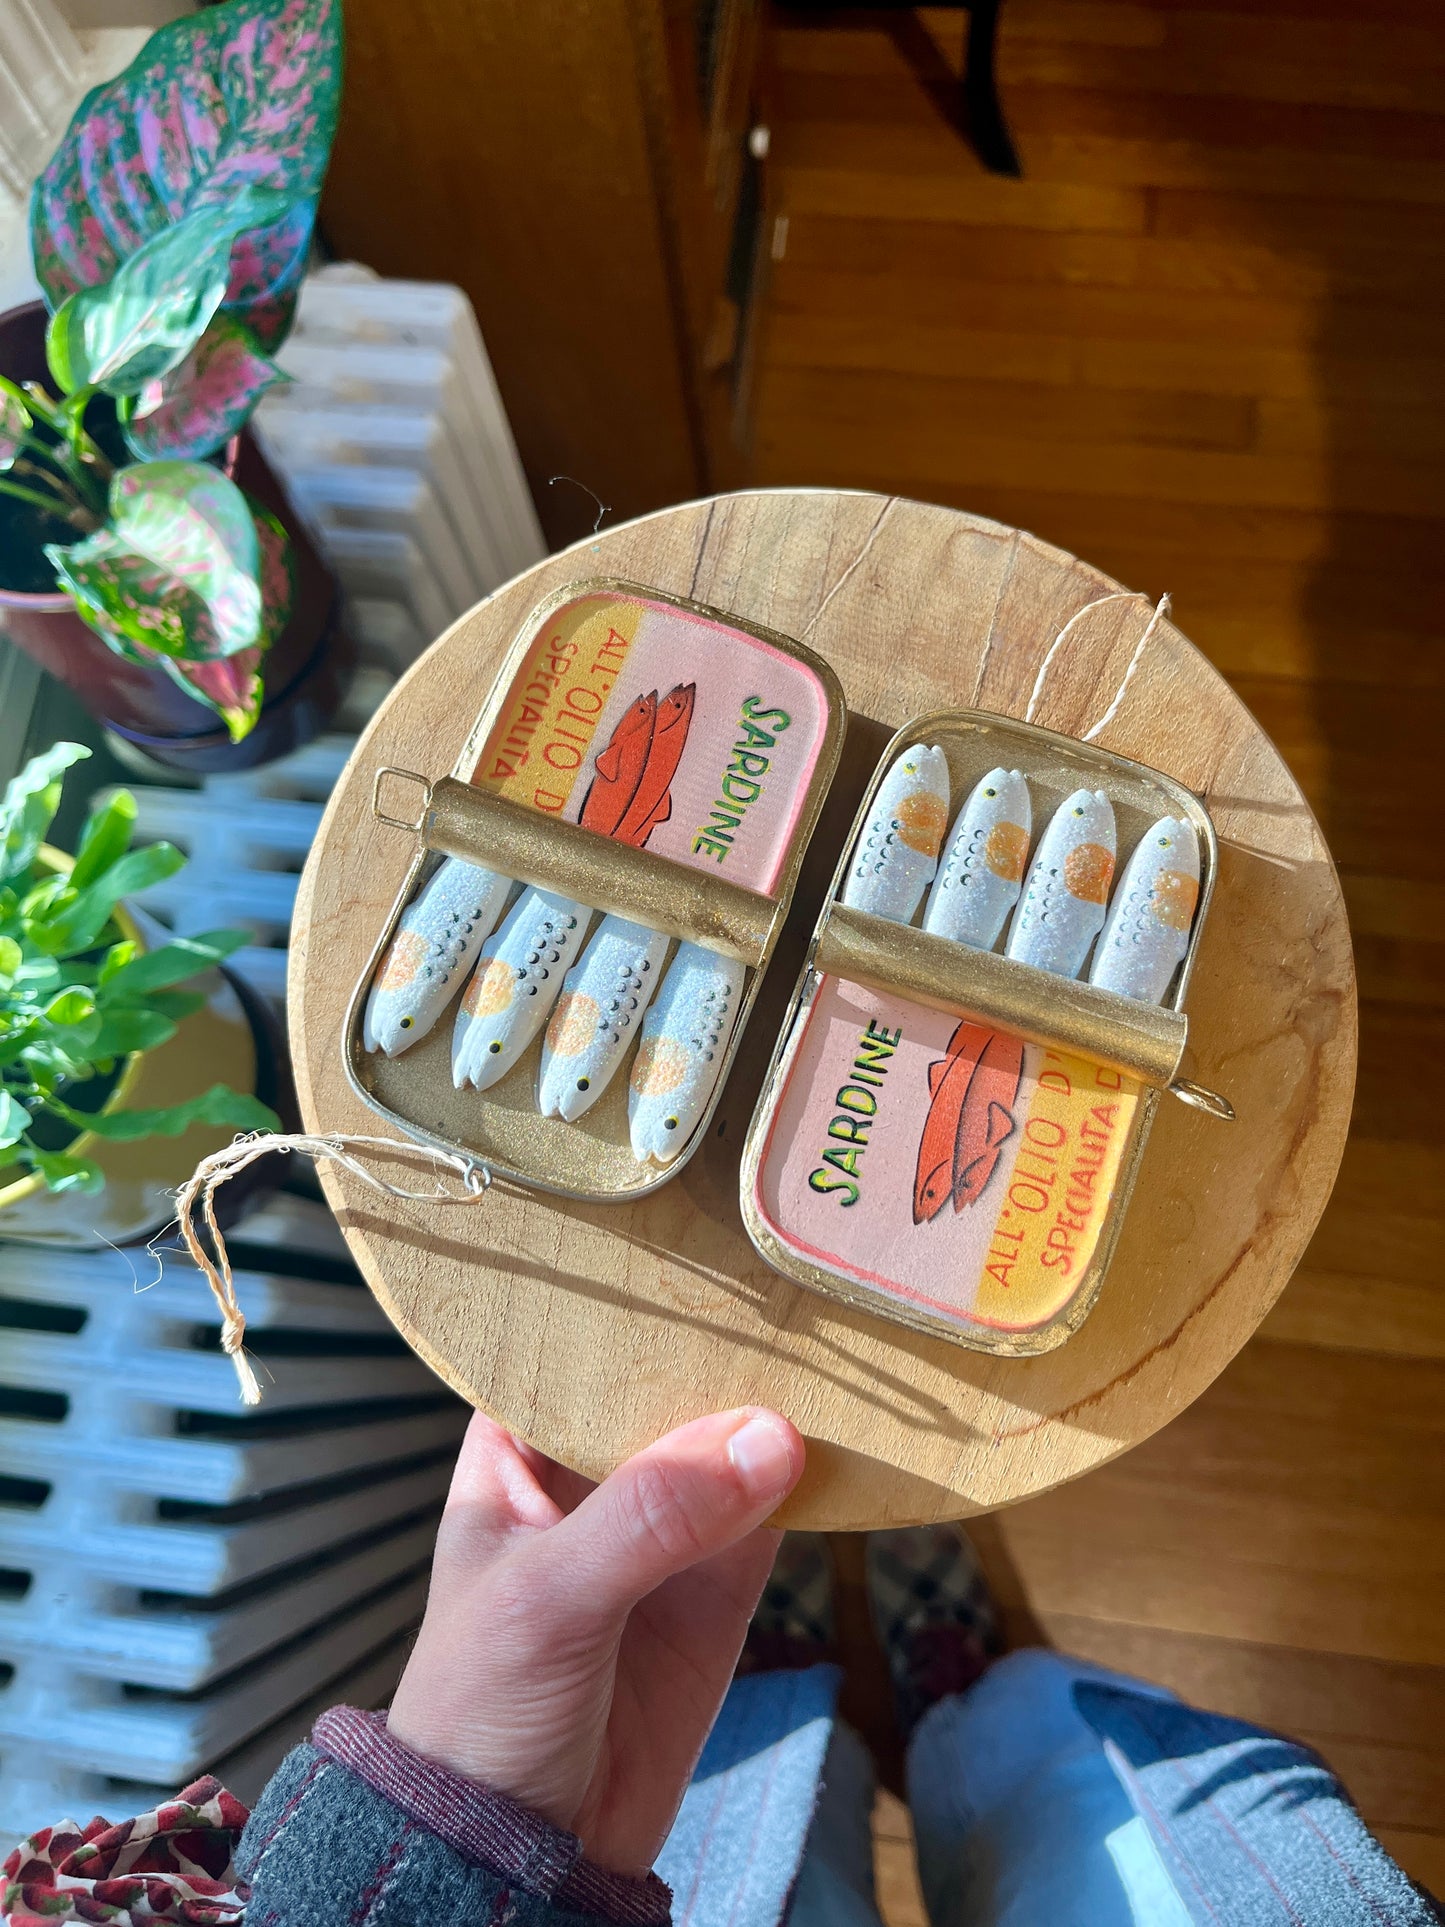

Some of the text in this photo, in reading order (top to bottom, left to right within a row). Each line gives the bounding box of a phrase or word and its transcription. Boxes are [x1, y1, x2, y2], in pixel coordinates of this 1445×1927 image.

[488, 635, 579, 778] SPECIALITA
[691, 695, 792, 864] SARDINE
[808, 1019, 902, 1207] SARDINE
[1040, 1104, 1120, 1276] SPECIALITA
